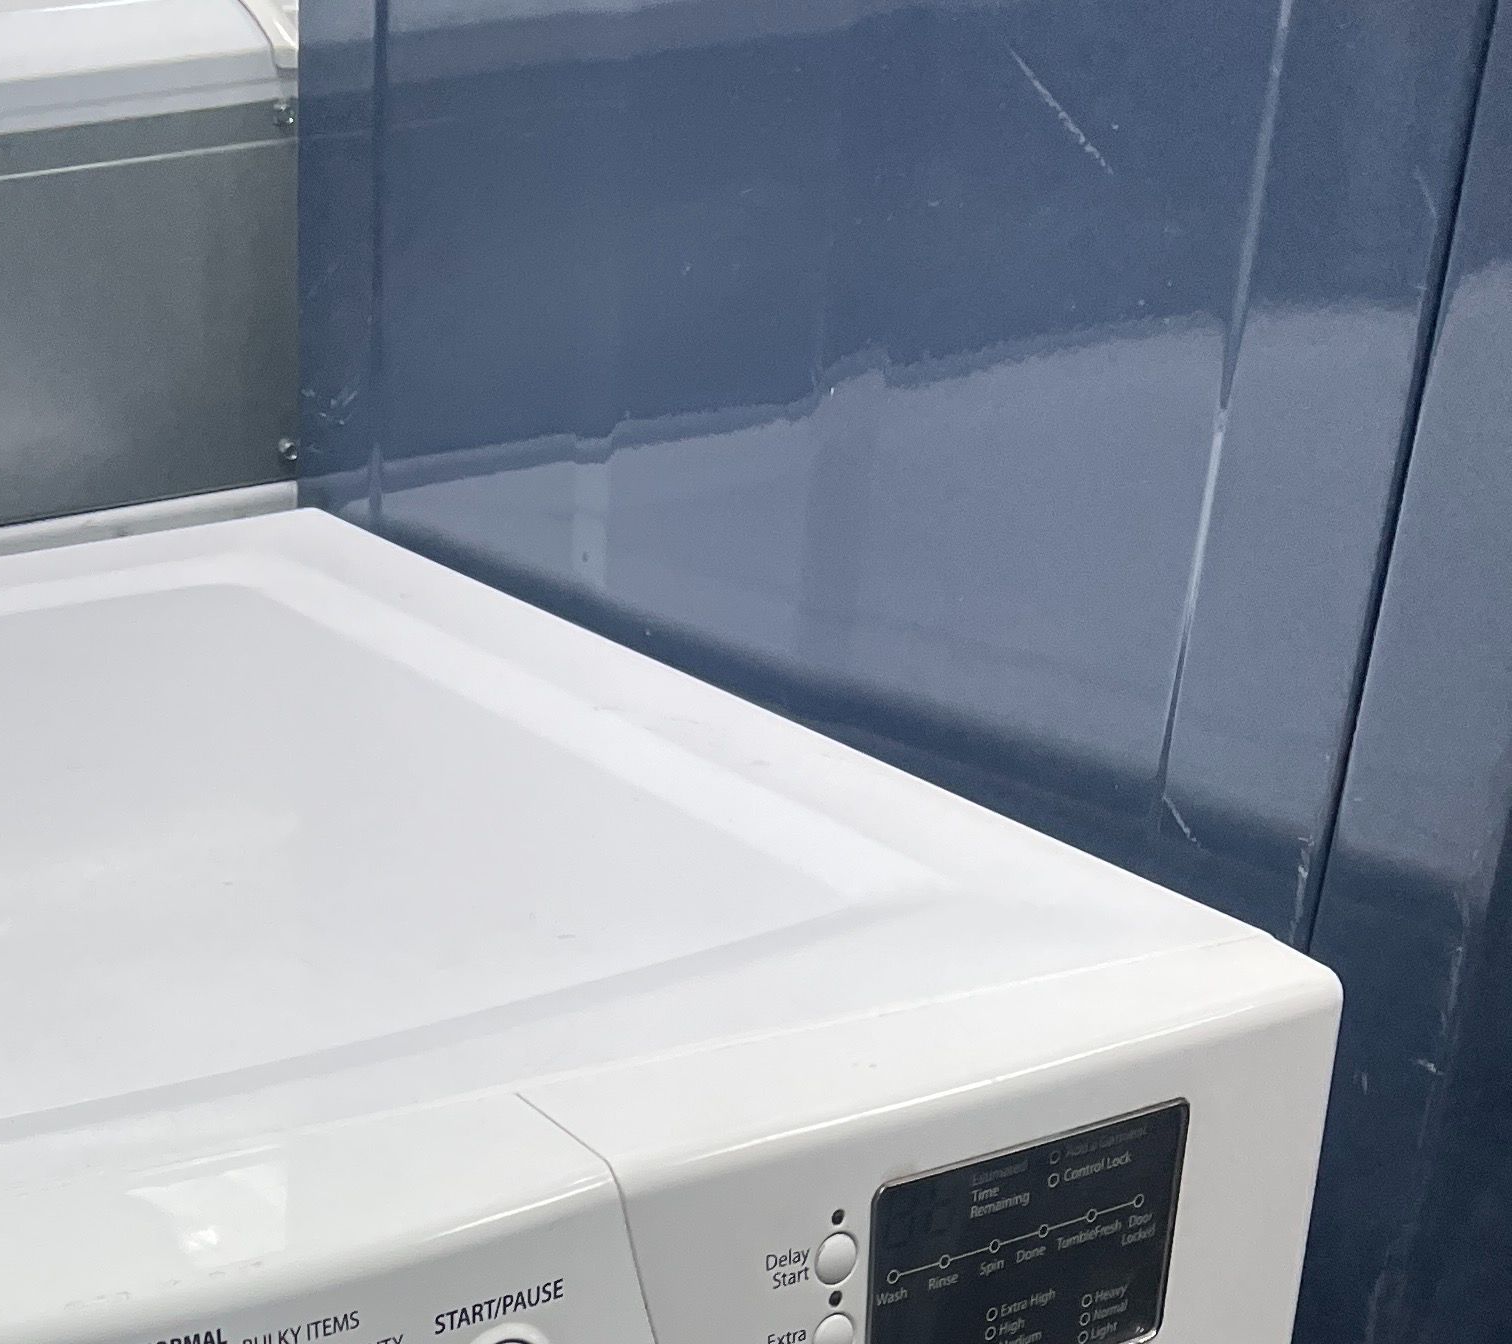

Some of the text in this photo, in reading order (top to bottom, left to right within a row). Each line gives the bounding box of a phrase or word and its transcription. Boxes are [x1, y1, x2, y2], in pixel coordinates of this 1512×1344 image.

[1064, 1150, 1132, 1181] Control Lock
[972, 1185, 1000, 1202] Time
[970, 1190, 1030, 1219] Remaining
[1128, 1213, 1153, 1229] Door
[1056, 1219, 1122, 1250] TumbleFresh
[1121, 1225, 1156, 1248] Locked
[766, 1247, 810, 1272] Delay
[1016, 1244, 1047, 1265] Done
[980, 1257, 1005, 1277] Spin
[773, 1266, 809, 1290] Start
[928, 1273, 959, 1290] Rinse
[876, 1288, 908, 1306] Wash
[1001, 1288, 1056, 1317] Extra High
[1094, 1283, 1129, 1302] Heavy
[434, 1278, 565, 1334] START/PAUSE
[1093, 1300, 1129, 1321] Normal
[307, 1310, 361, 1342] ITEMS
[999, 1317, 1025, 1336] High
[1091, 1322, 1118, 1339] Light
